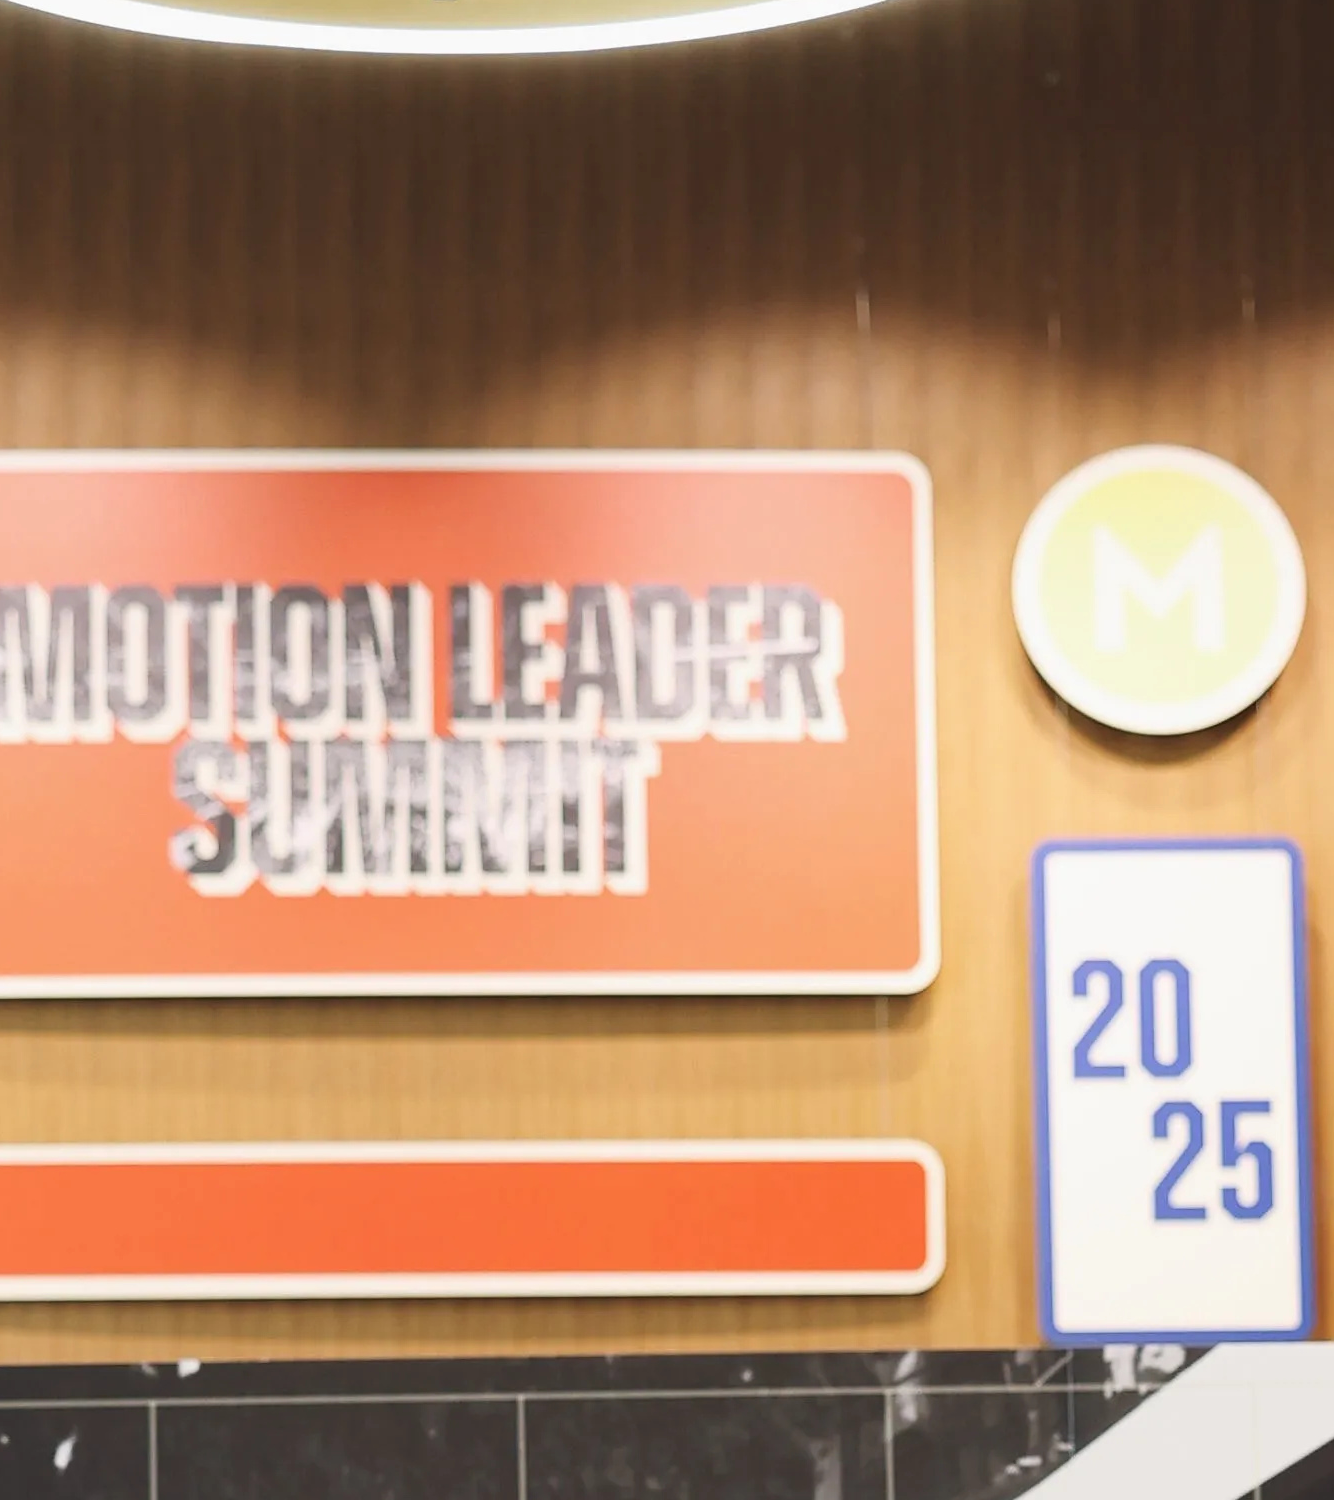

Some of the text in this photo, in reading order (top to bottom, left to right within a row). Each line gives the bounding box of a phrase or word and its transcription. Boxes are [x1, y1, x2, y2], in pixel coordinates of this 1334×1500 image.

[1092, 520, 1225, 652] M
[447, 582, 846, 742] LEADER
[170, 740, 660, 896] SUMMIT
[1072, 959, 1192, 1078] 20
[1152, 1100, 1274, 1220] 25
